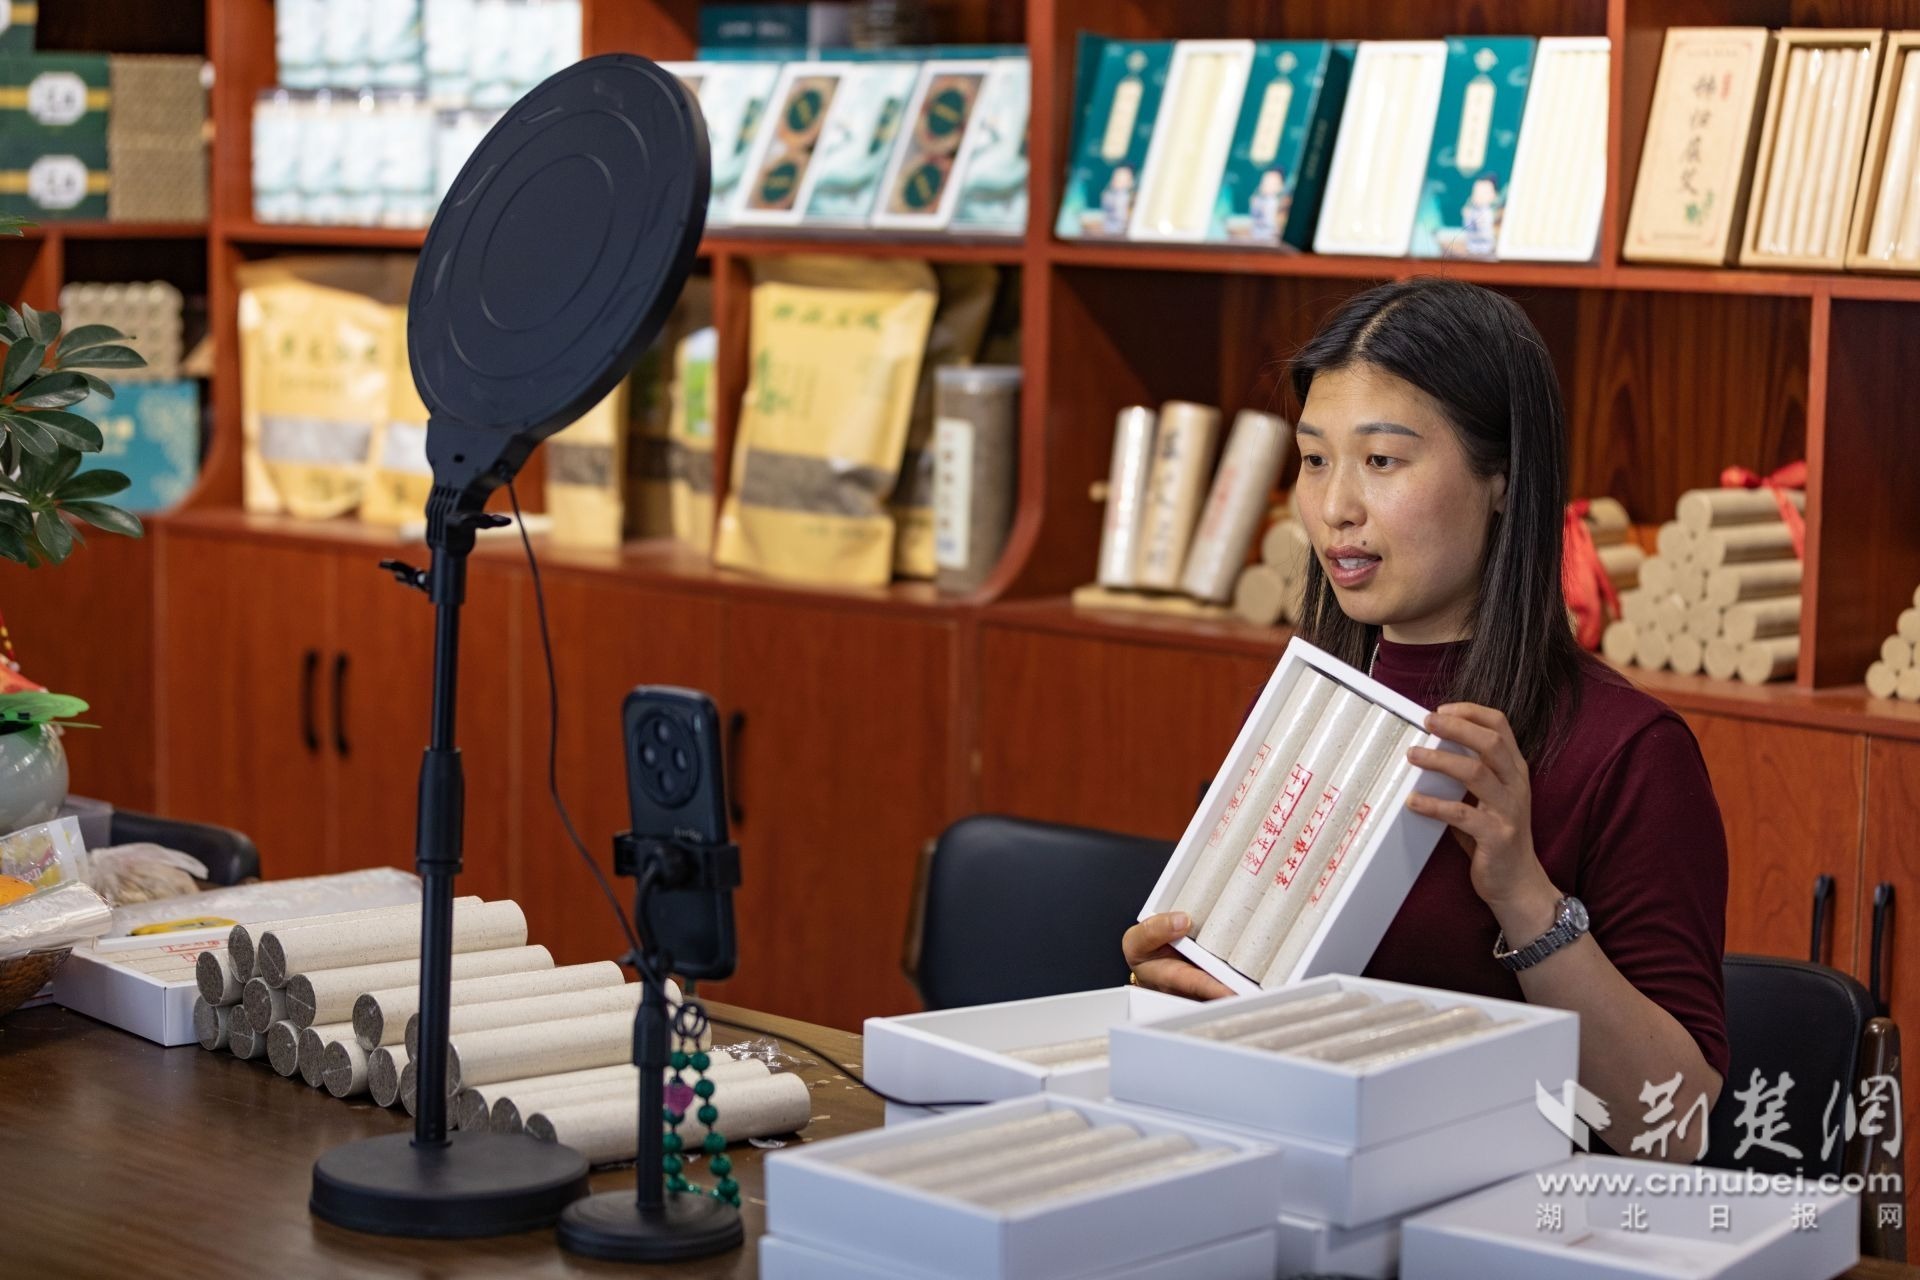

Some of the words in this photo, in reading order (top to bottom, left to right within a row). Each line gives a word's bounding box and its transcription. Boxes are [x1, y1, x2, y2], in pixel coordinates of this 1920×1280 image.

[1244, 768, 1307, 872] 手工石磨艾条
[1274, 791, 1335, 888] 手工石磨艾条
